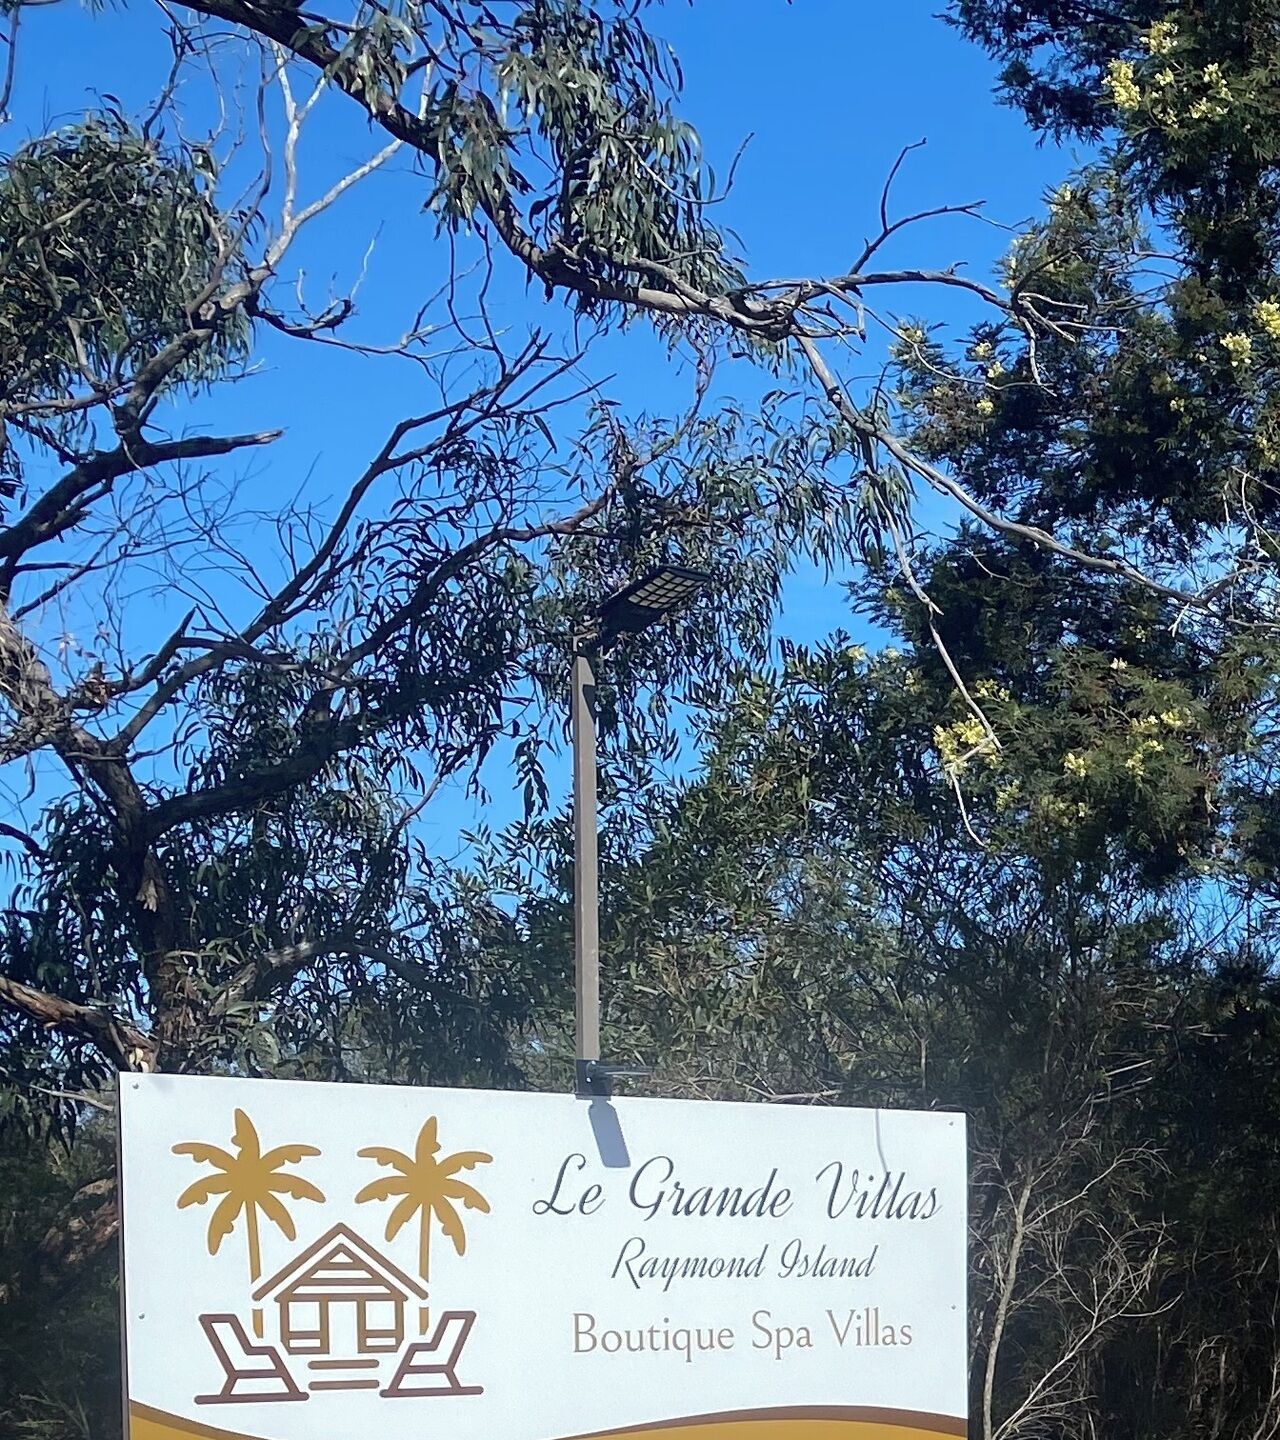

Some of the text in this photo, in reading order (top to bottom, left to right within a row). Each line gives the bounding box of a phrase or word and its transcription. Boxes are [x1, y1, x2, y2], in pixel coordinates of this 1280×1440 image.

[531, 1152, 942, 1222] Le Grande Villas
[611, 1237, 878, 1292] Raymond Island
[571, 1307, 913, 1364] Boutique Spa Villas
